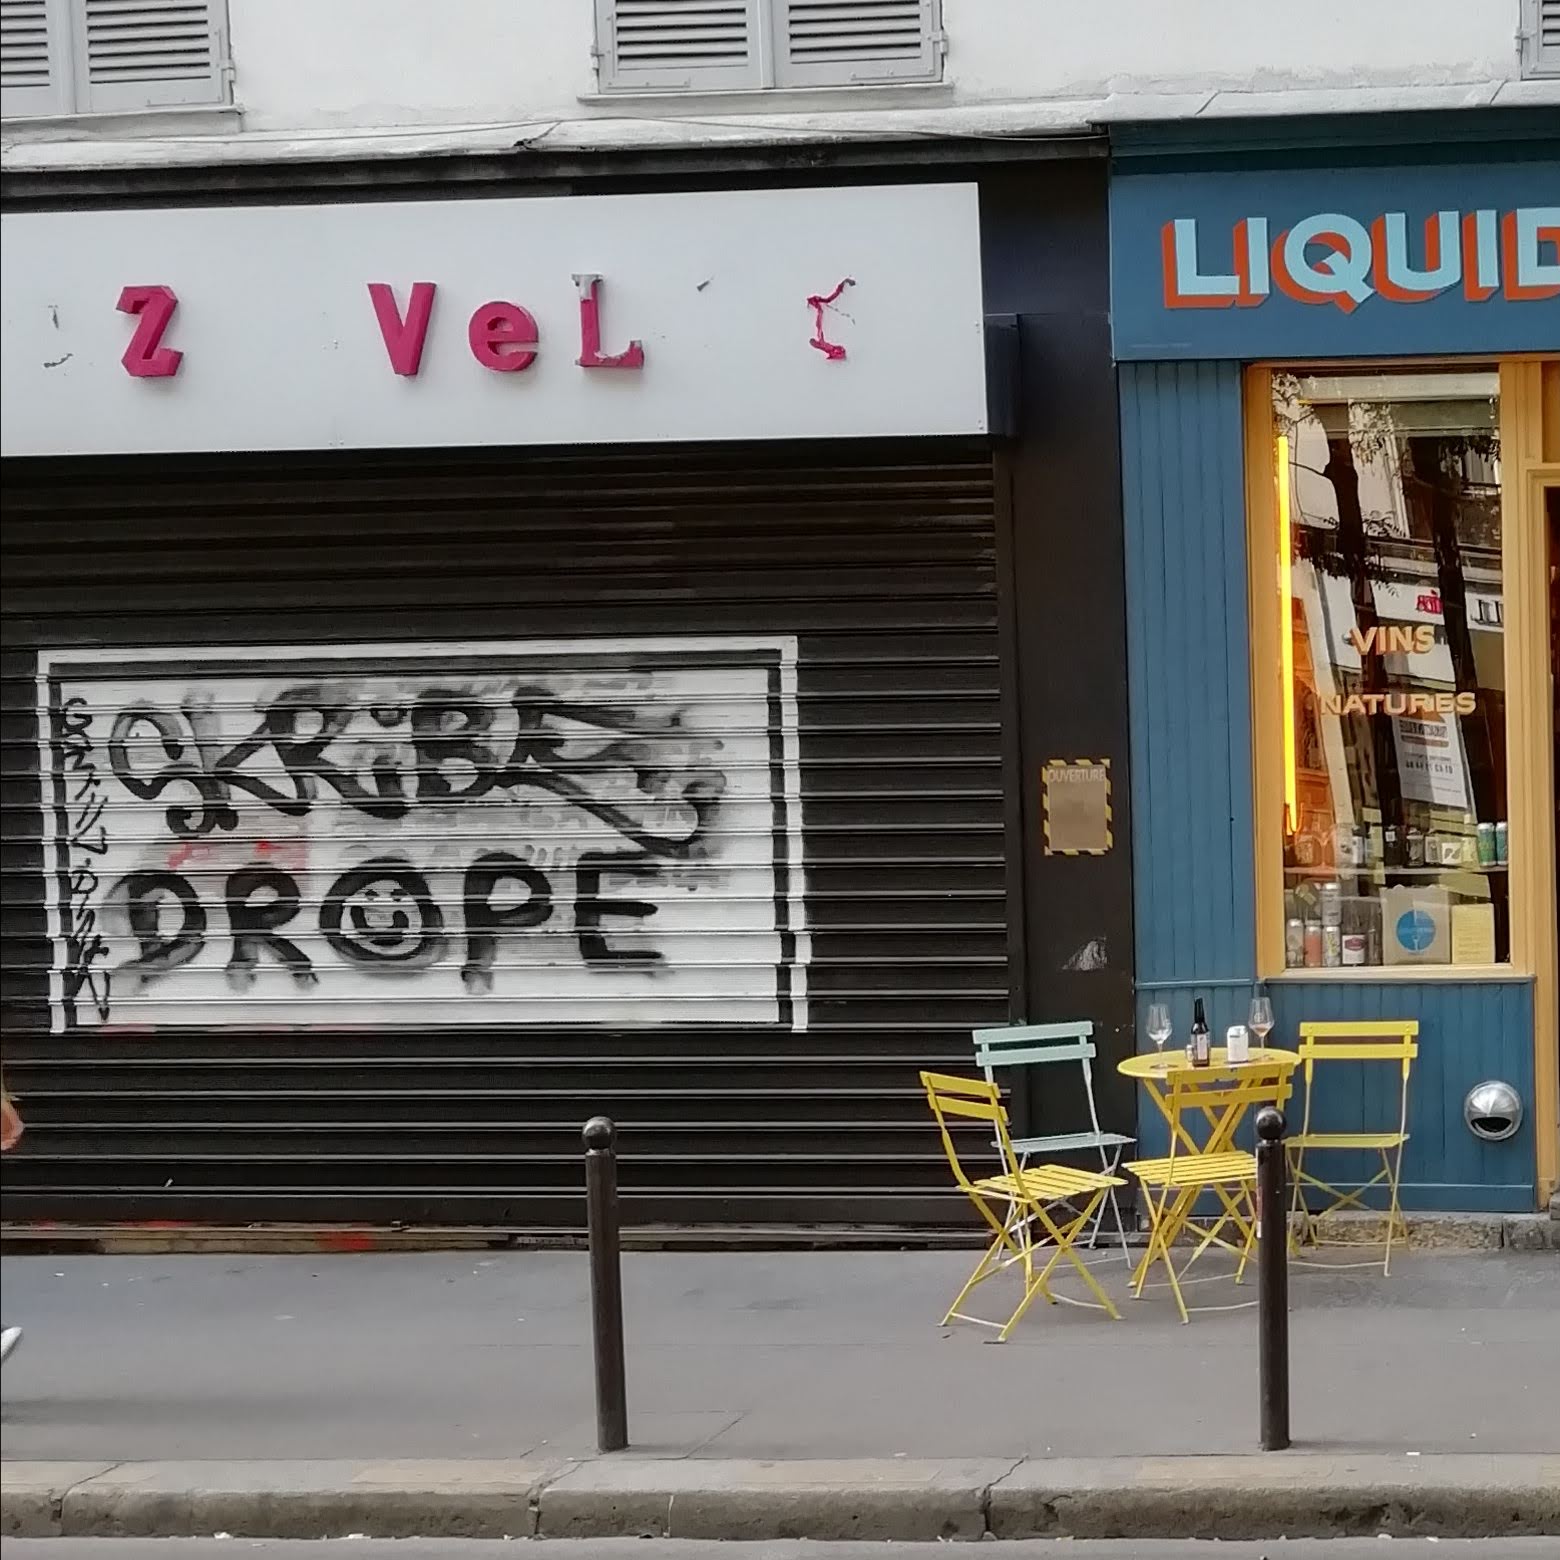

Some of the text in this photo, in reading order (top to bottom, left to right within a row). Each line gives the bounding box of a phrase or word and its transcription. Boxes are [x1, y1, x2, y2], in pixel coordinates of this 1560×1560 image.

[1350, 624, 1435, 656] VINS
[1320, 692, 1477, 715] NATURES
[1048, 768, 1105, 782] OUVERTURE
[100, 850, 672, 995] DROPE
